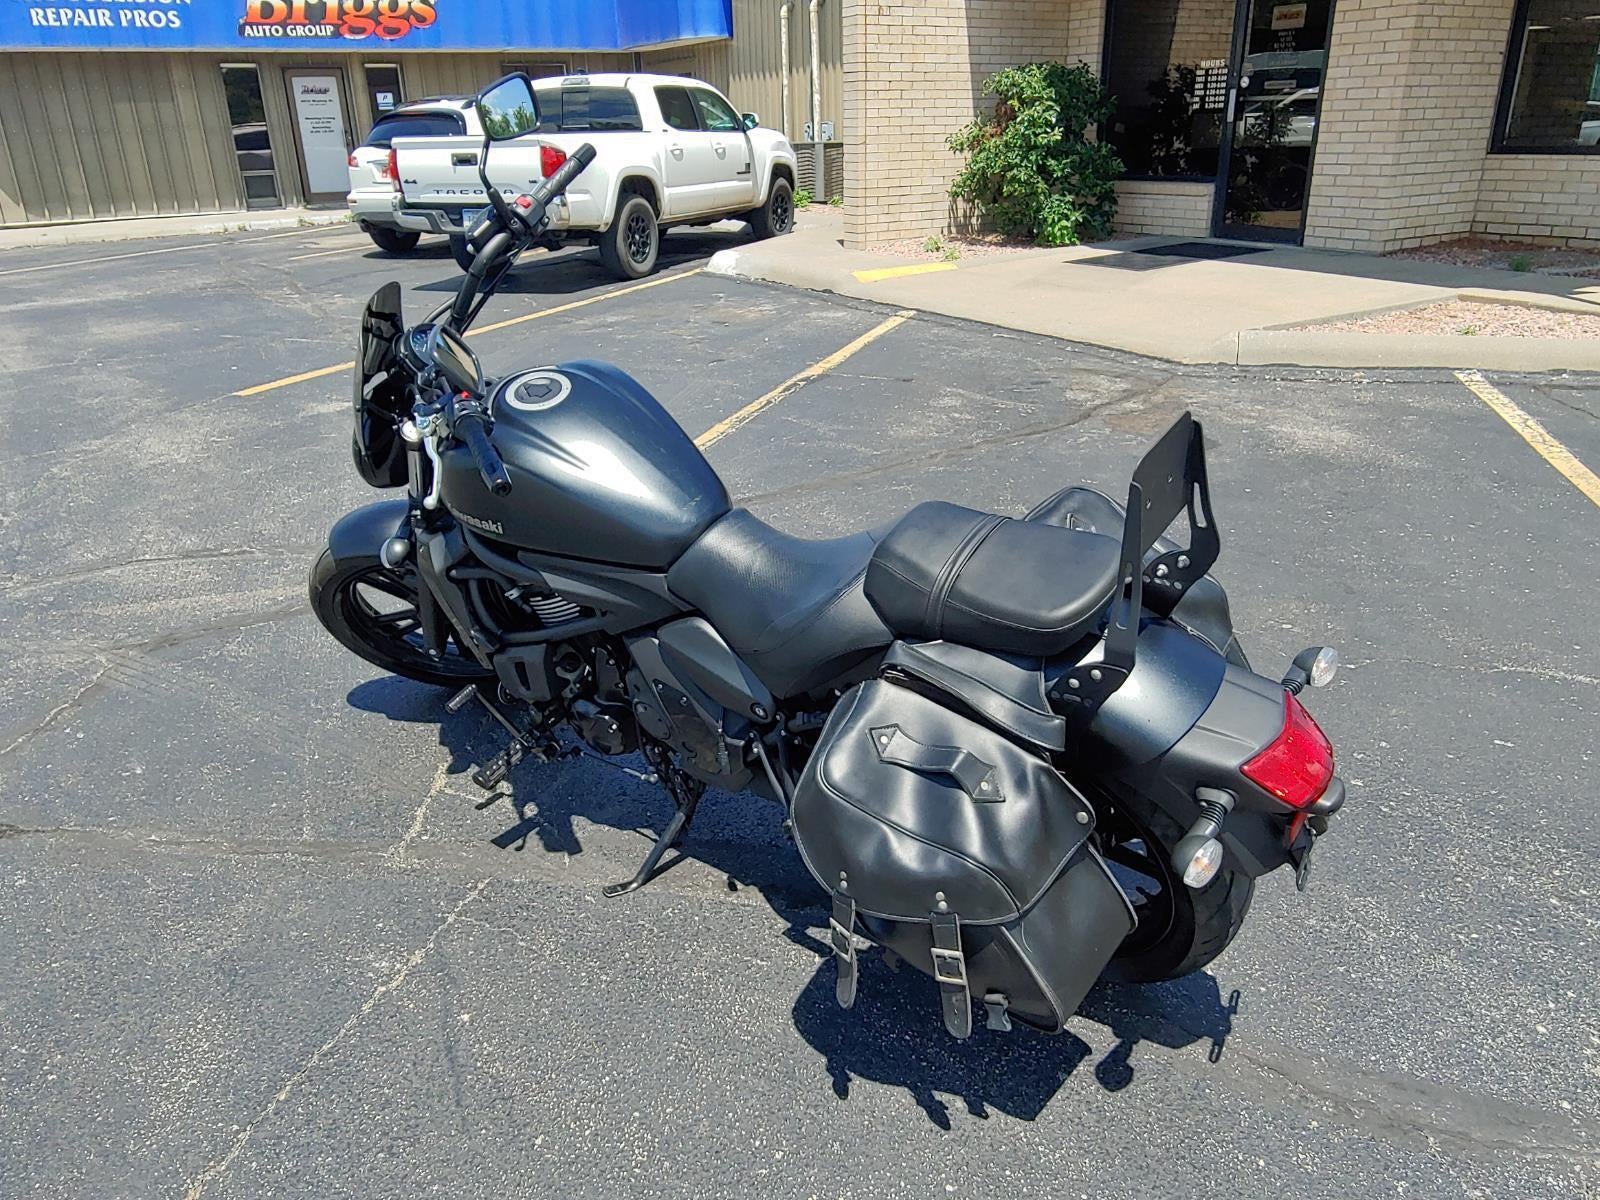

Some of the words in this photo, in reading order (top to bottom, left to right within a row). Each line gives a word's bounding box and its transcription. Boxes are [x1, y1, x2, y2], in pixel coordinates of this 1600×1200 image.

[30, 7, 114, 27] REPAIR
[119, 9, 182, 28] PROS
[245, 0, 436, 39] Briggs
[244, 25, 283, 37] AUTO
[286, 25, 335, 37] GROUP
[1200, 59, 1226, 68] HOURS
[432, 188, 514, 196] TACOA
